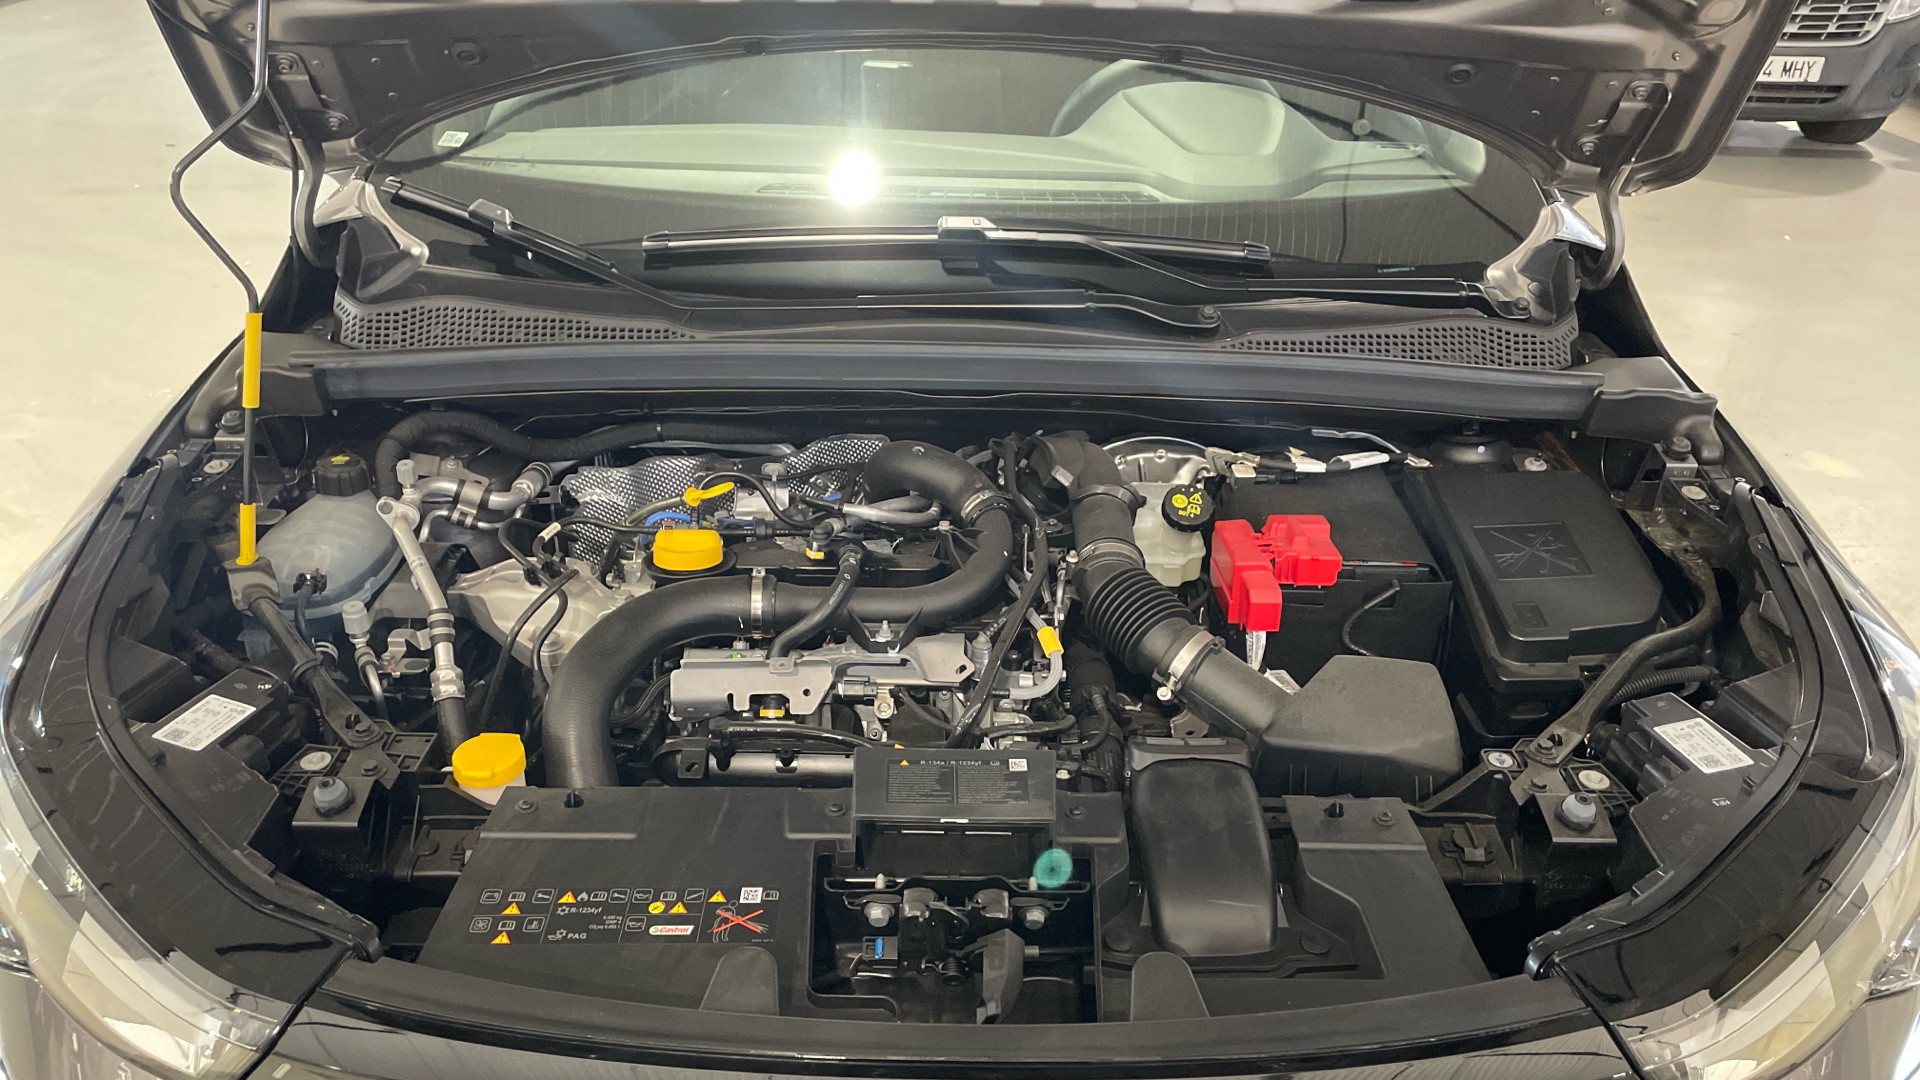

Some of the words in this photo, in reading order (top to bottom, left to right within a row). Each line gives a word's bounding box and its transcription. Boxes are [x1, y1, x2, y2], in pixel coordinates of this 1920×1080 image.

[1763, 60, 1774, 77] 4
[1780, 60, 1816, 79] MHY
[569, 906, 602, 915] R-1234yf
[659, 926, 690, 934] Castrol
[567, 932, 587, 940] PAG
